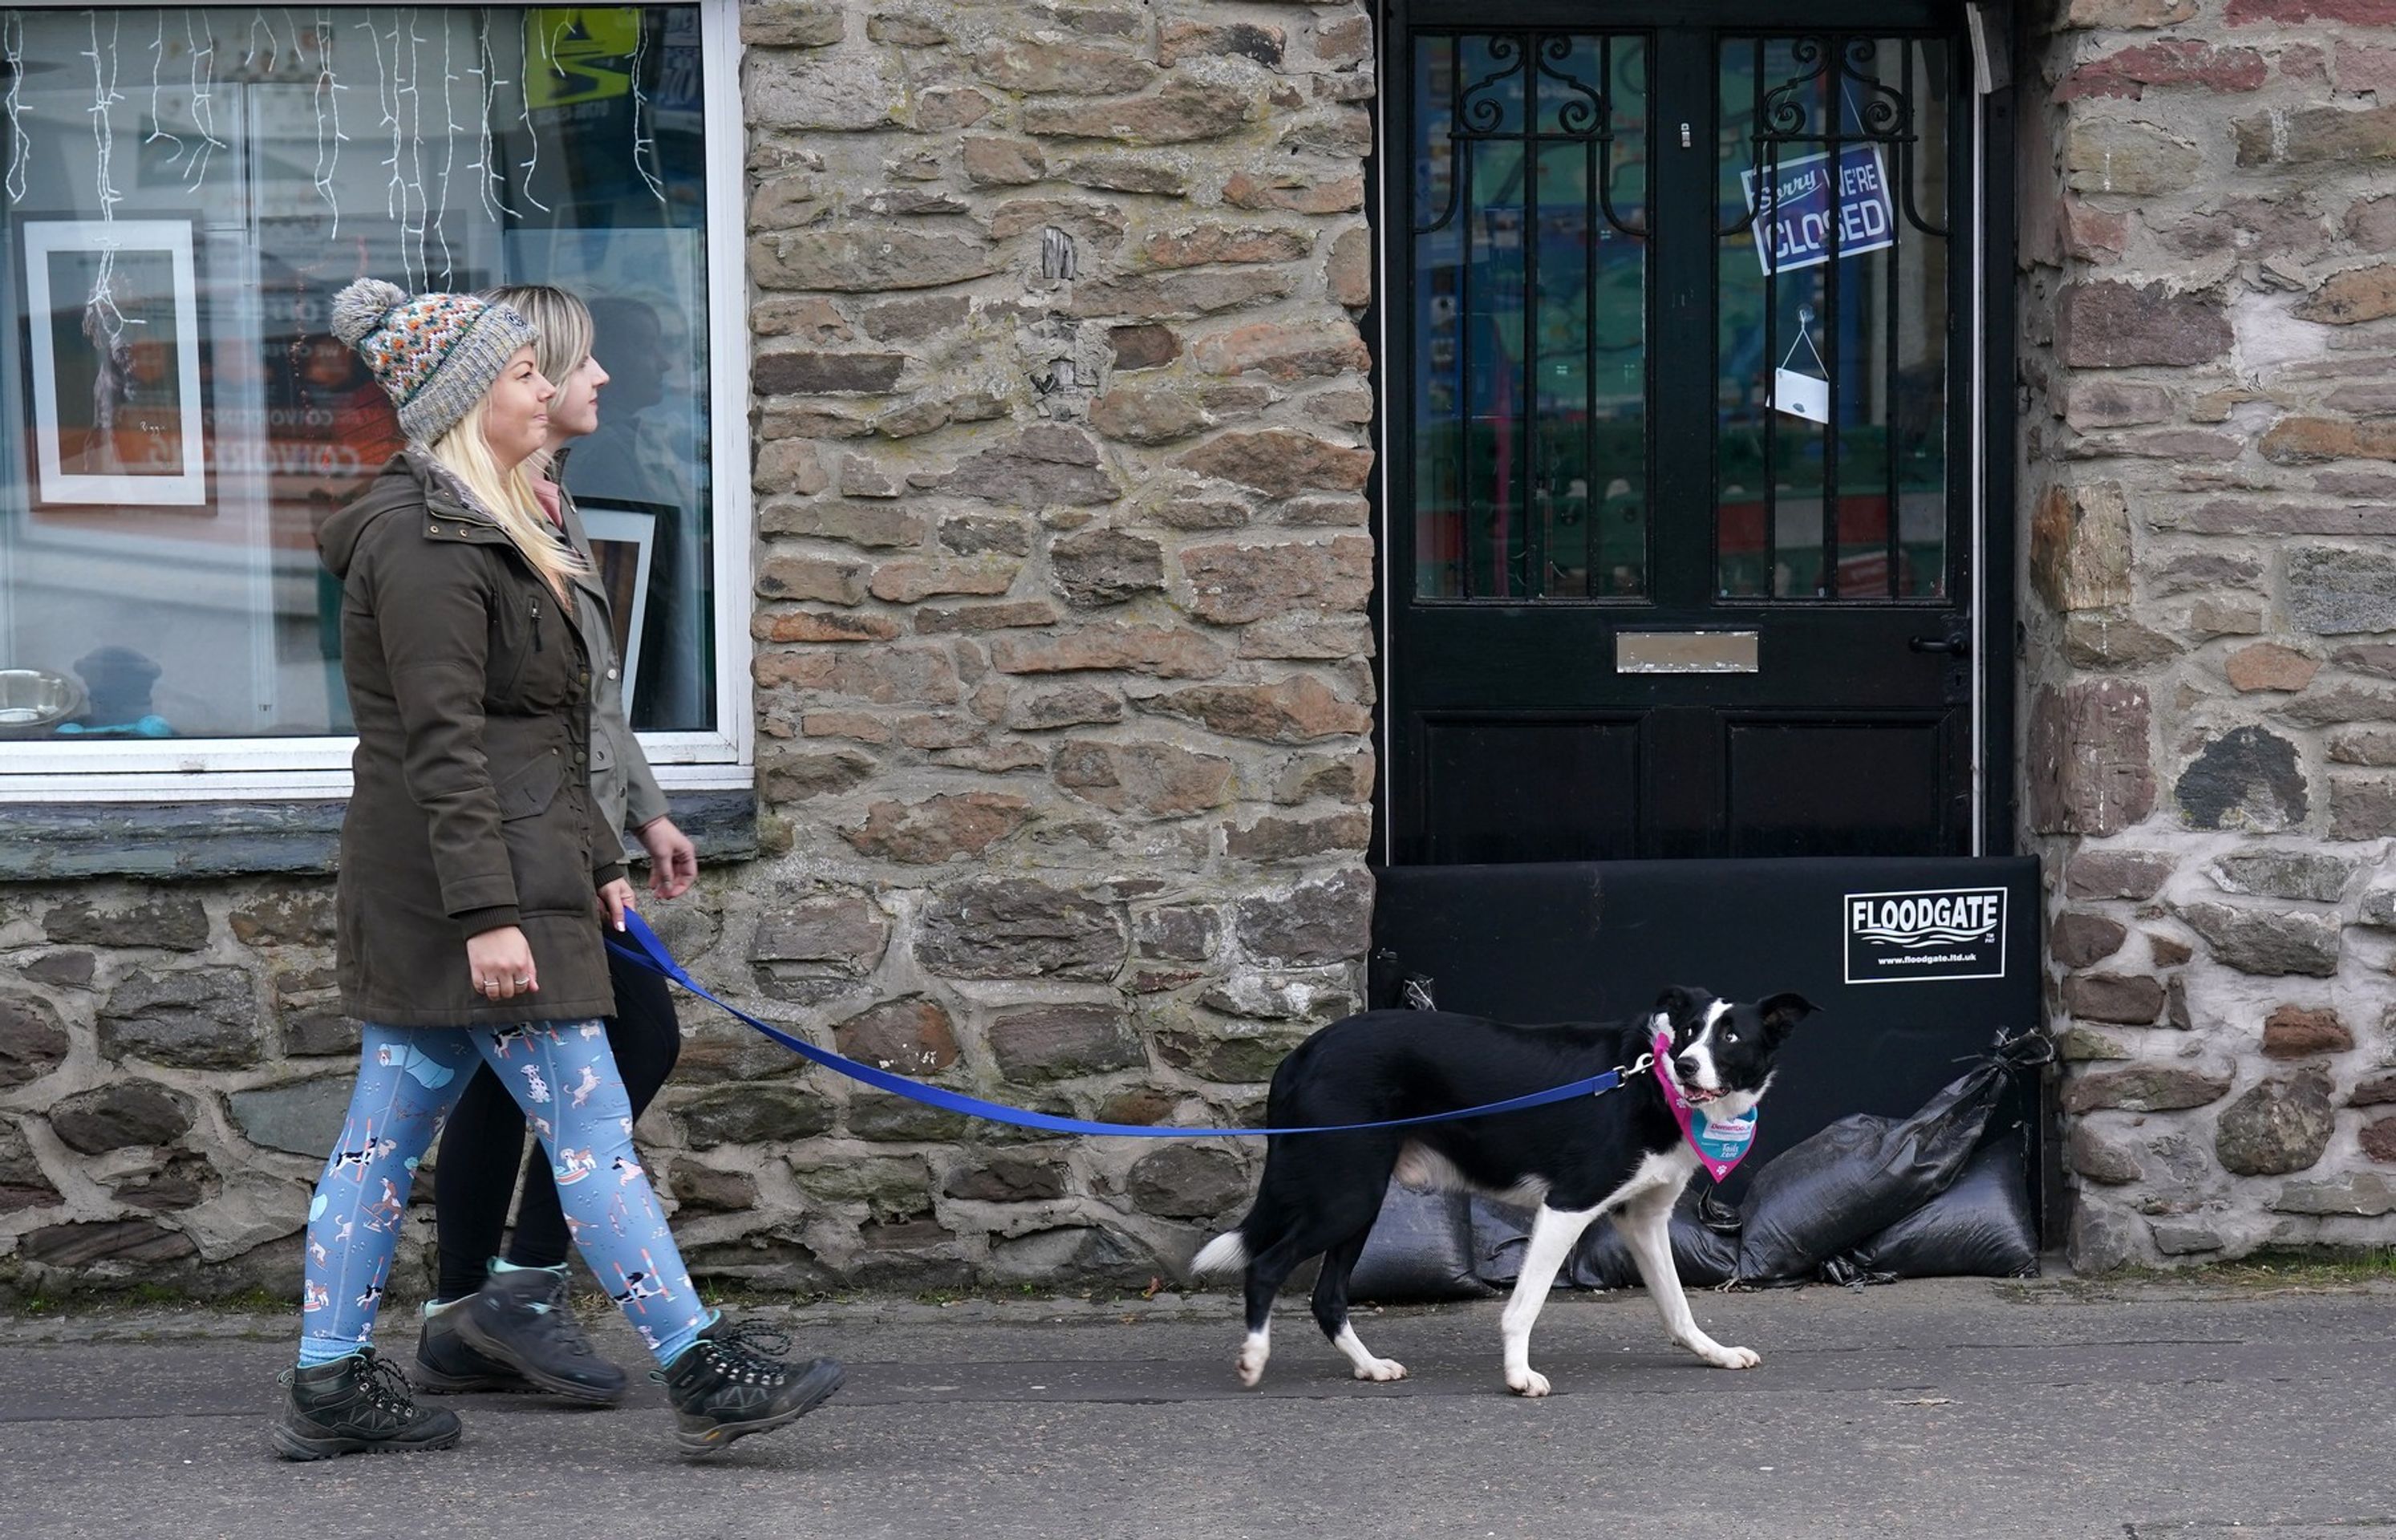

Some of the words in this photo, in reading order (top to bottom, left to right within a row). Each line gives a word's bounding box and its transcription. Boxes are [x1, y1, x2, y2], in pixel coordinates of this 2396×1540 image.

[1760, 170, 1817, 210] Sorry
[1822, 163, 1879, 198] WE'RE
[1765, 199, 1886, 258] CLOSED
[1852, 895, 1998, 932] FLOODGATE
[1878, 953, 1976, 965] www.floodgate.ltd.uk
